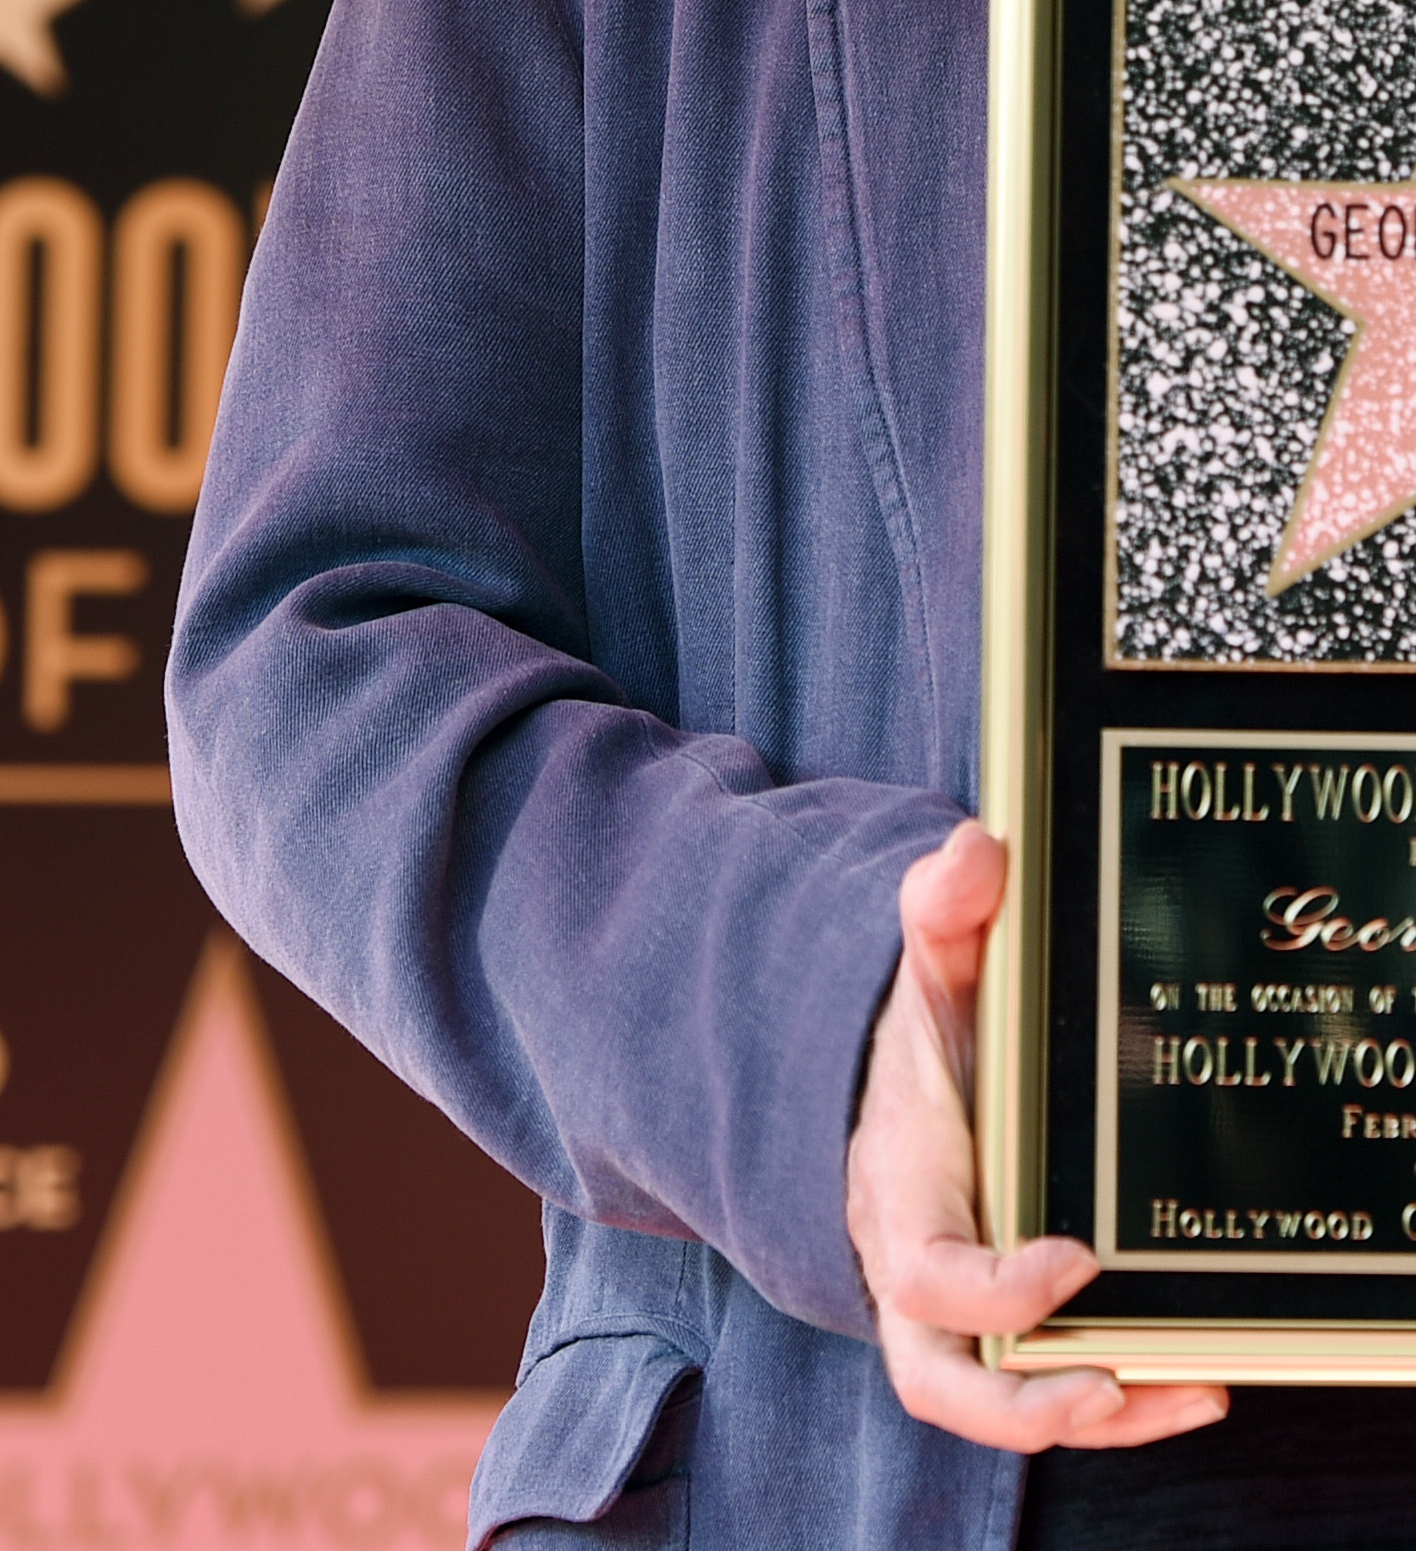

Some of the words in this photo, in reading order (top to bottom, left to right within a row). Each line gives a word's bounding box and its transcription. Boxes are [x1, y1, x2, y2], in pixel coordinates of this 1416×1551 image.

[1149, 982, 1180, 1010] ON
[1196, 982, 1237, 1011] THE
[1251, 982, 1355, 1013] OCCASION
[1369, 985, 1395, 1013] OF
